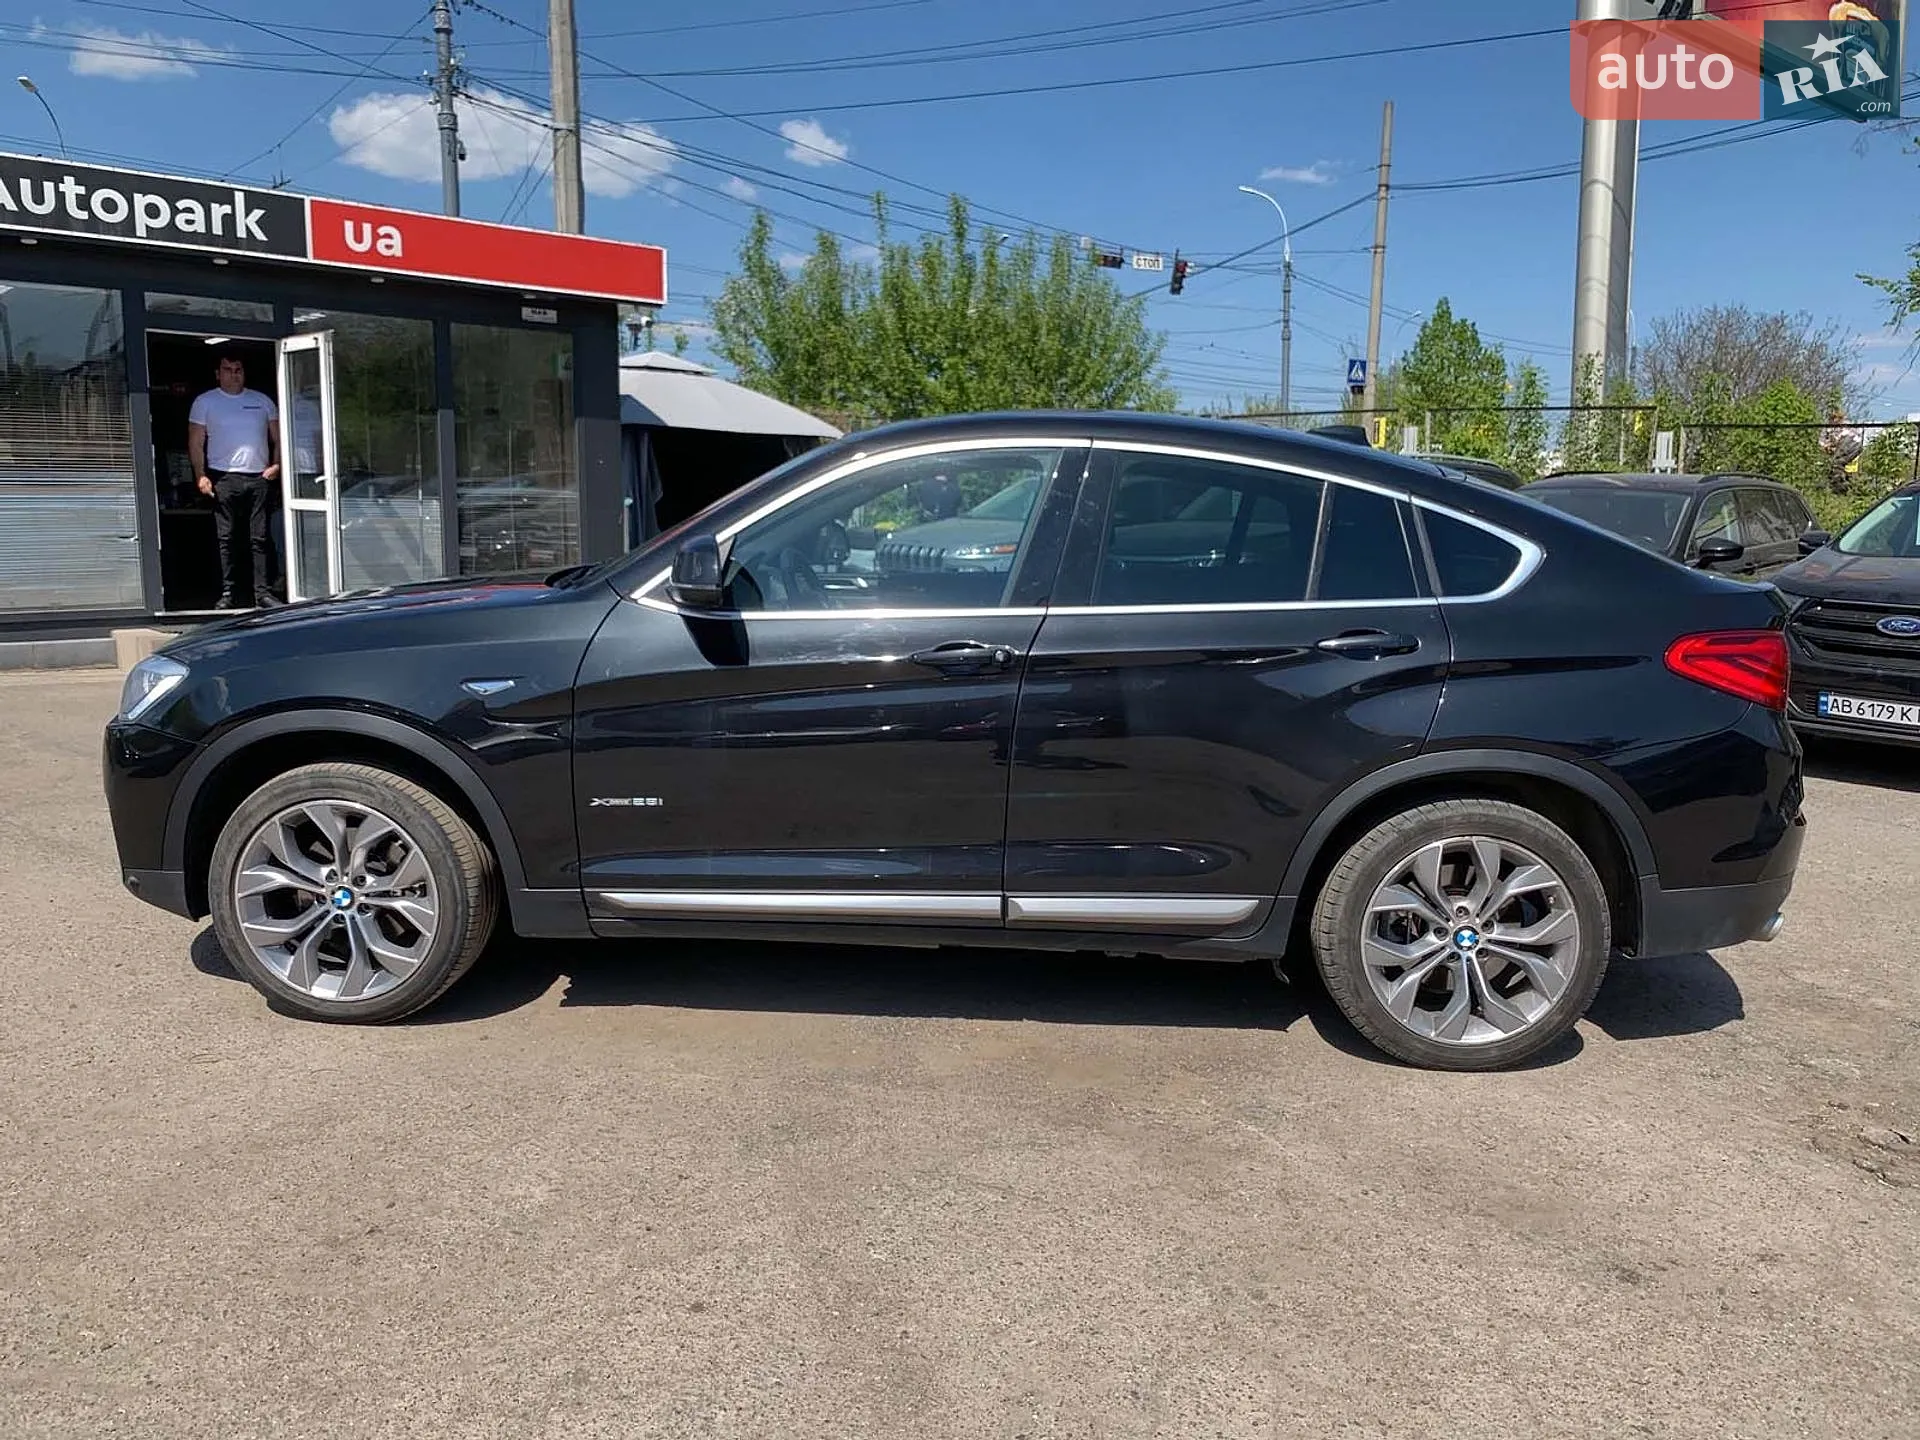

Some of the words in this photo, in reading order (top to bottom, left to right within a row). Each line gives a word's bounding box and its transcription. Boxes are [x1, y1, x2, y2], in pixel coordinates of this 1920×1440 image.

[343, 219, 404, 258] ua
[1830, 698, 1853, 714] AB
[1856, 702, 1896, 720] 6179
[1900, 706, 1920, 724] K
